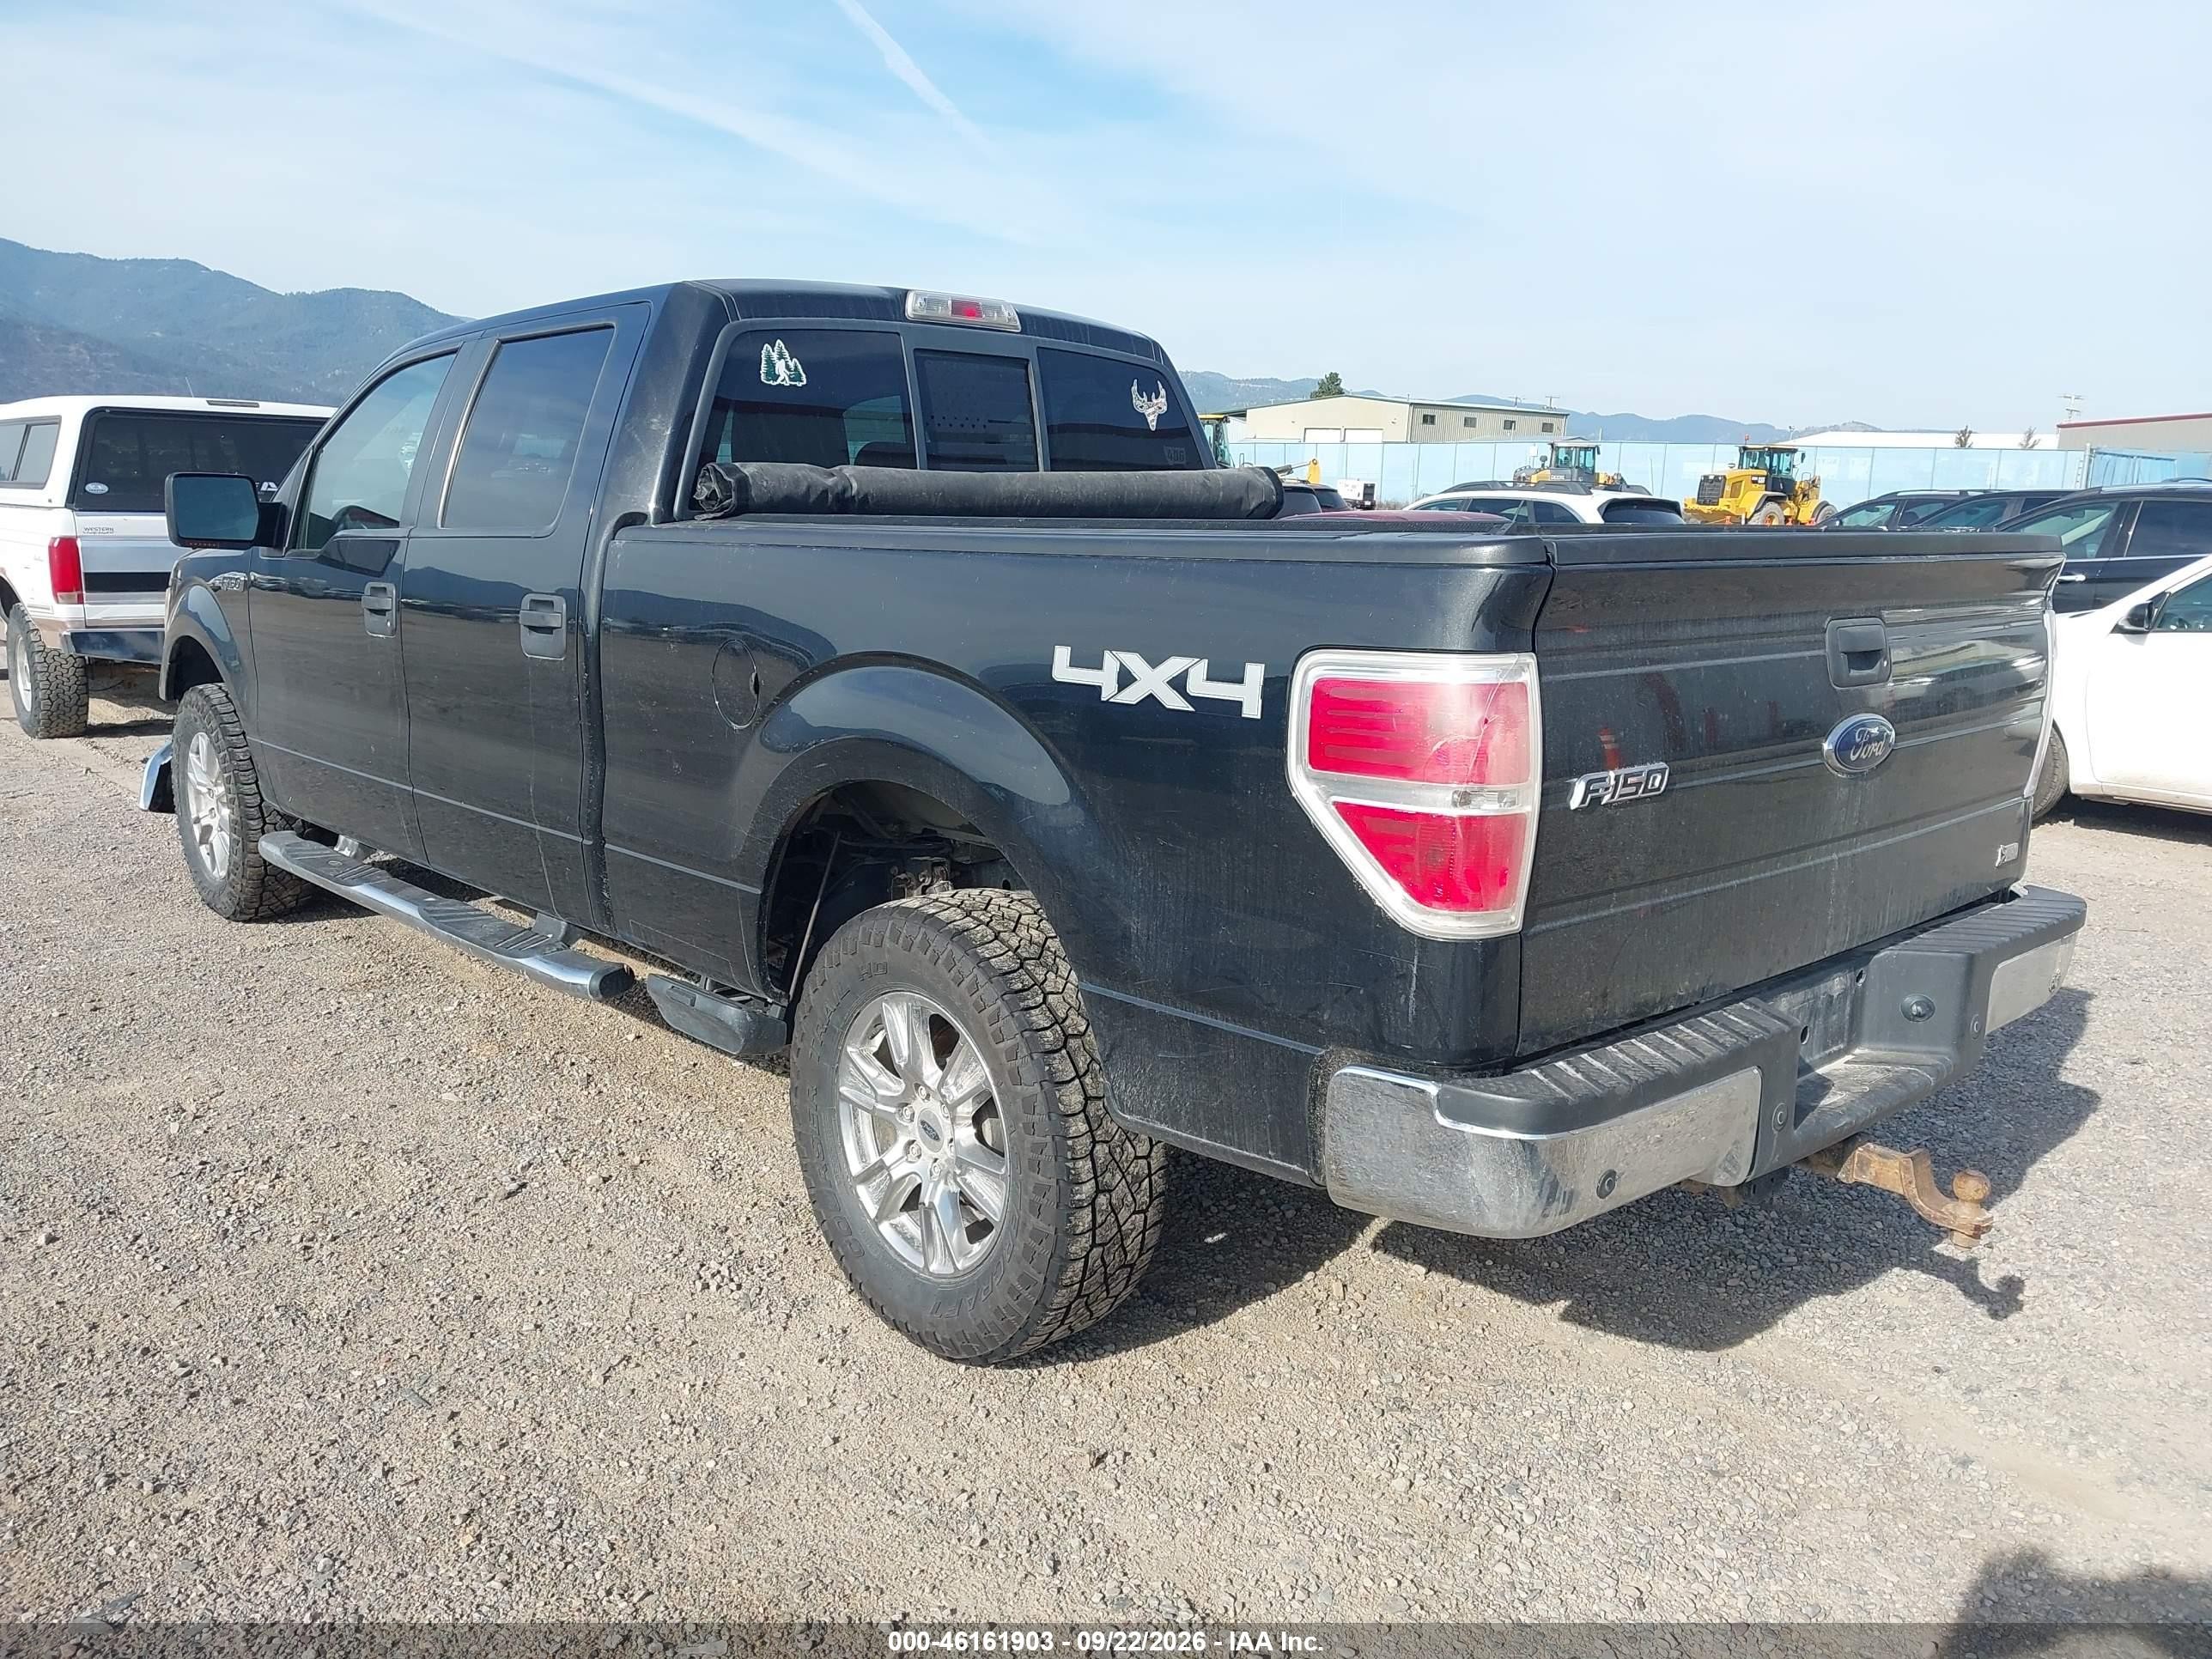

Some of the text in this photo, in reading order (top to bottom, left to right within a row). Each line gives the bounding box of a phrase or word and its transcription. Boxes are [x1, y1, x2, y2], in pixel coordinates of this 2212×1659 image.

[1850, 726, 1889, 762] Ford
[859, 961, 888, 981] HD
[930, 1084, 1023, 1319] ASTERCRAFT
